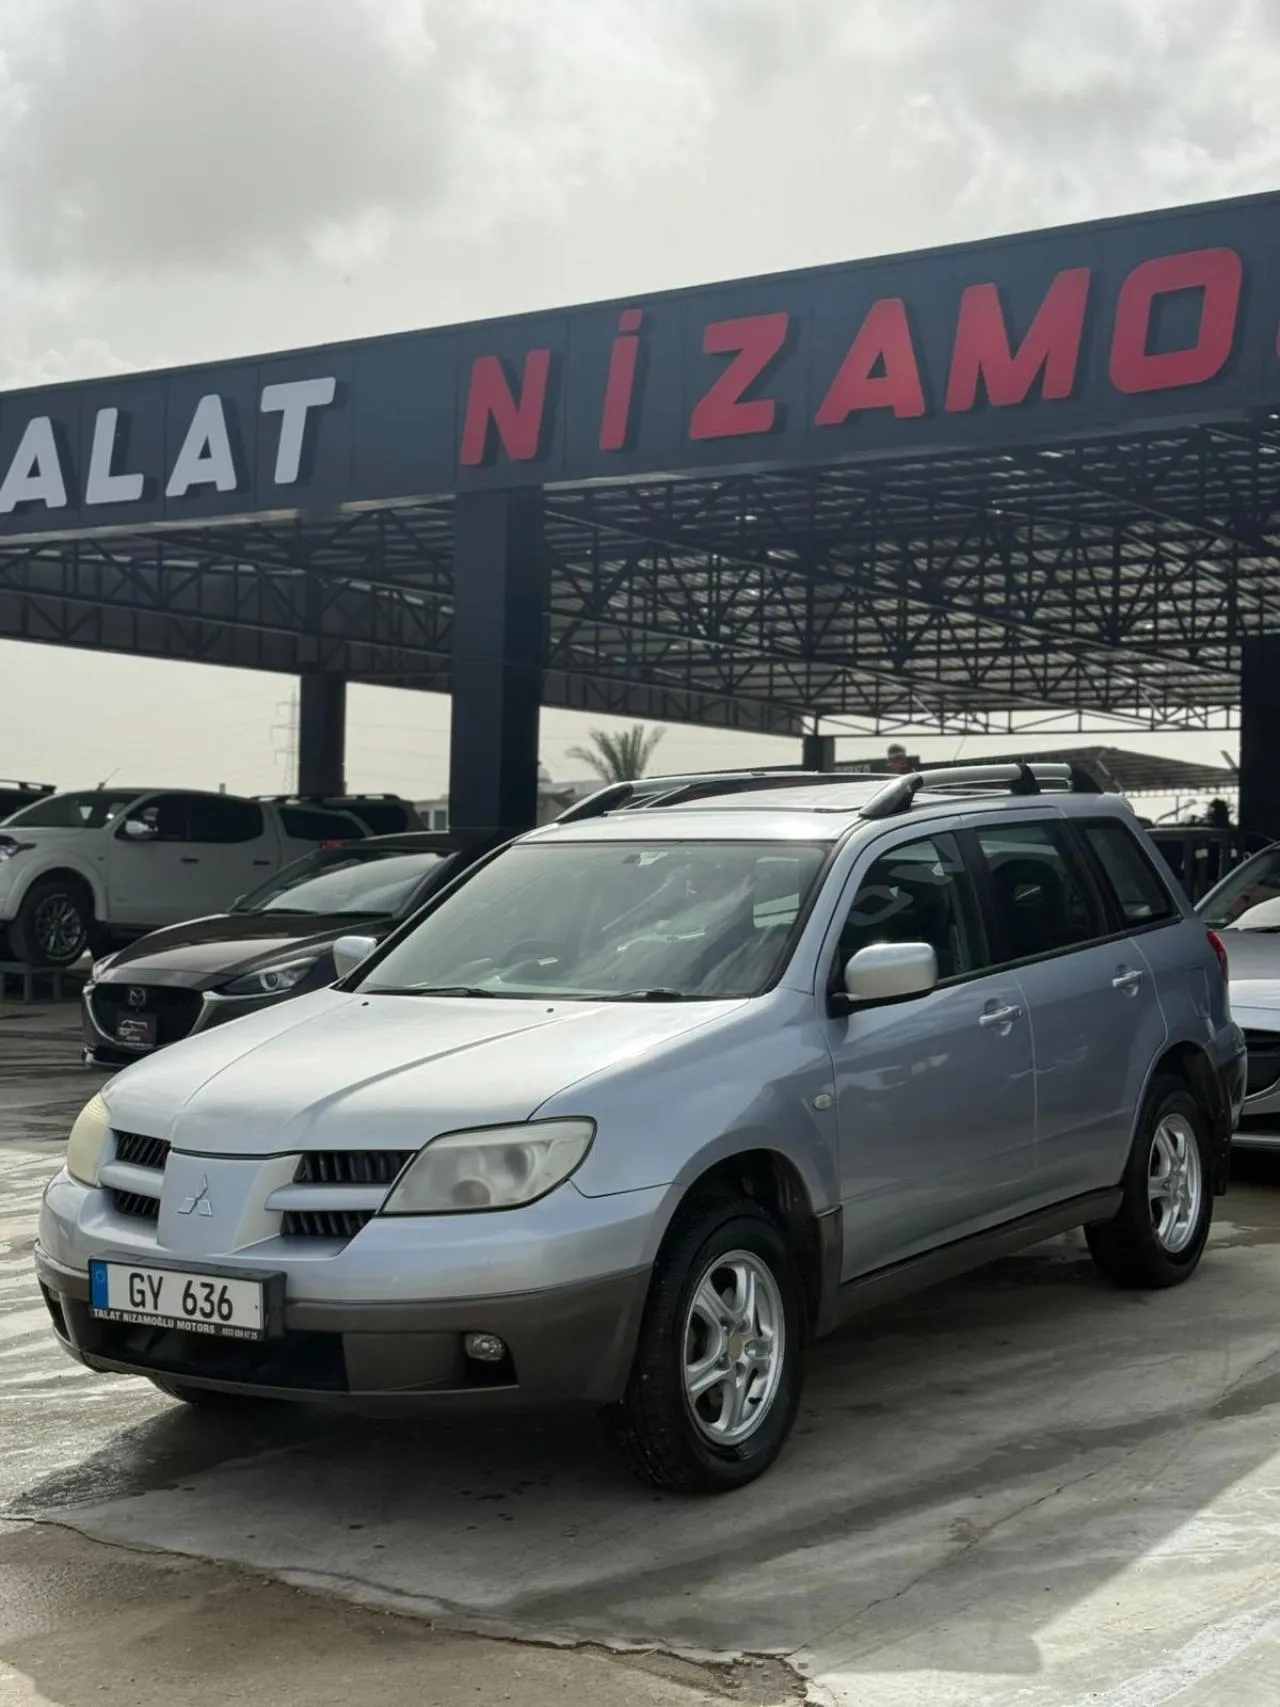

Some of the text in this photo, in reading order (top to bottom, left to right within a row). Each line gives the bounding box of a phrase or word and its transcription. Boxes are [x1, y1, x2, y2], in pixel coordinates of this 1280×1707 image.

[0, 247, 1280, 512] ALAT NİZAMO
[129, 1273, 233, 1321] GY 636
[94, 1309, 121, 1321] TALAT
[176, 1320, 216, 1335] MOTORS
